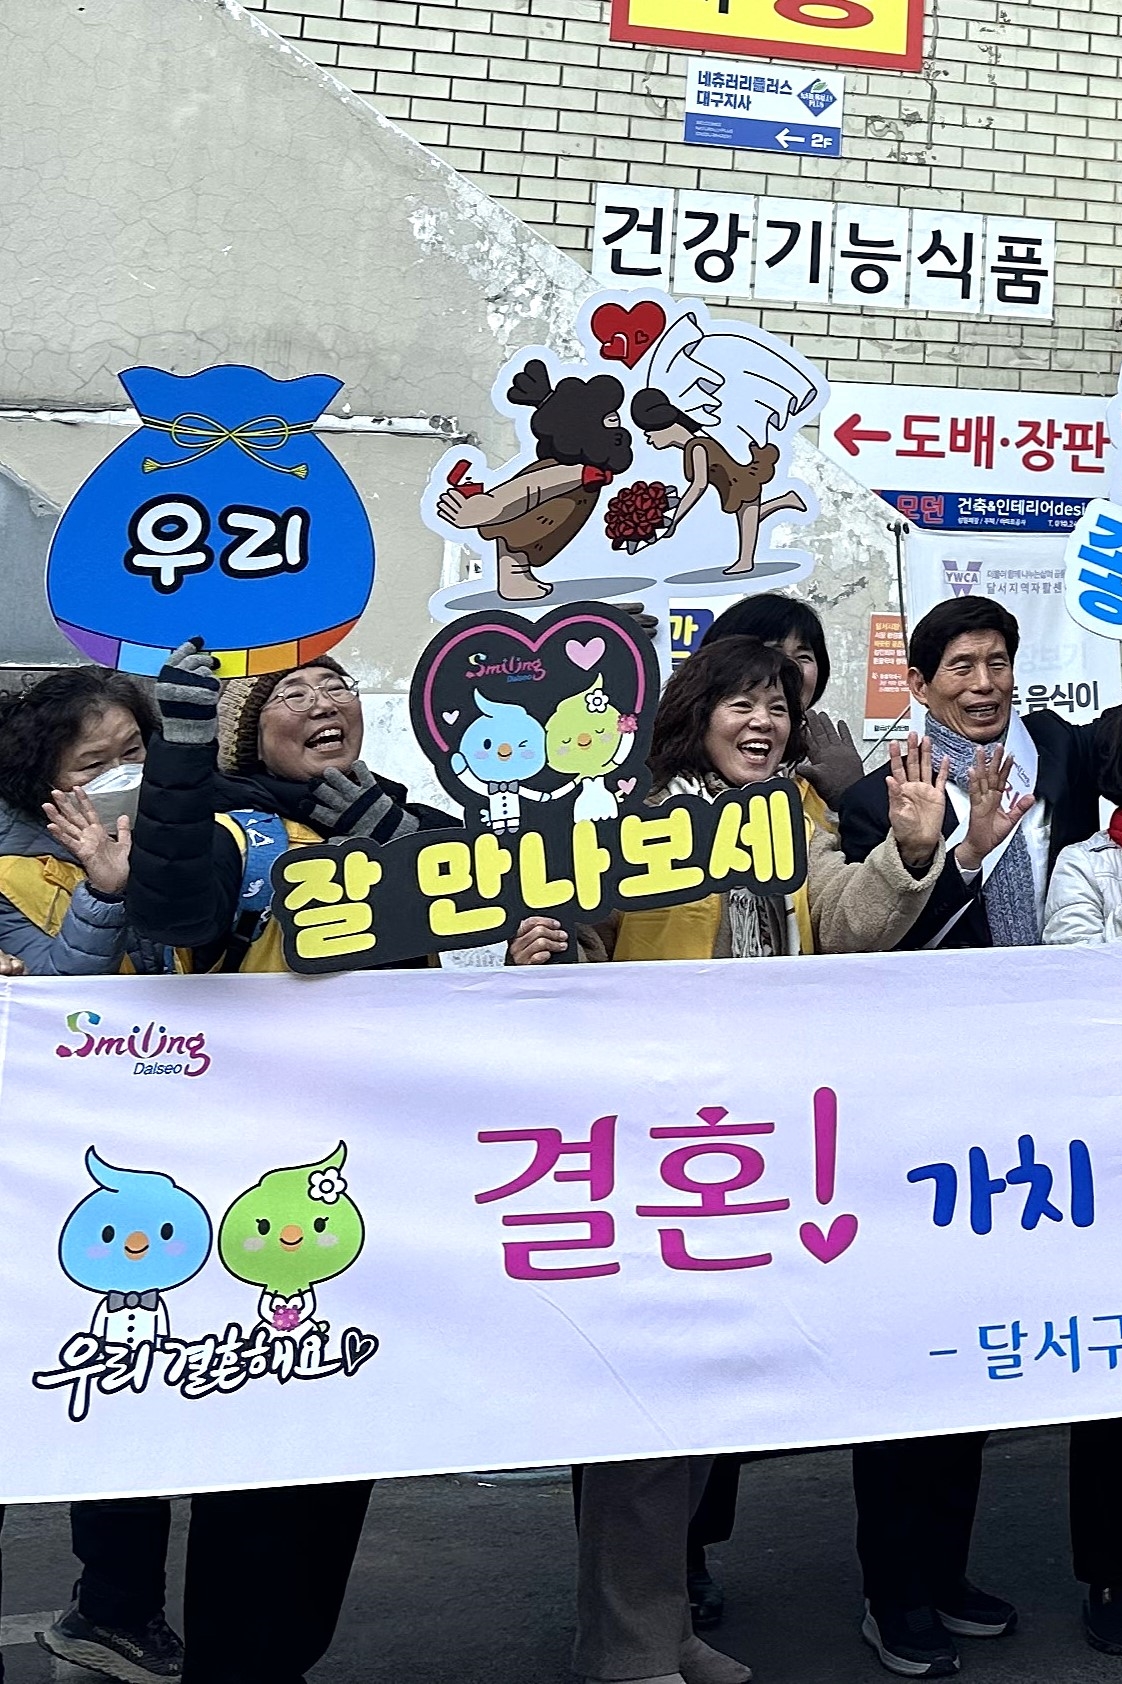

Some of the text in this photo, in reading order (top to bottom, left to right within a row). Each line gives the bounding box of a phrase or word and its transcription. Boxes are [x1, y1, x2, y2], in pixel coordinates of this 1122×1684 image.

[697, 71, 793, 95] 네츄러리플러스
[696, 90, 752, 111] 대구지사
[811, 133, 833, 149] 2F
[602, 204, 1049, 306] 건강기능식품
[896, 414, 1111, 474] 도배·장판
[897, 495, 944, 524] 모던
[129, 500, 305, 588] 우리
[945, 571, 979, 584] YWCA
[465, 653, 547, 681] Smiling
[1026, 681, 1099, 713] 음식이
[282, 789, 795, 958] 잘 만나보세
[55, 1011, 211, 1077] Smiling
[133, 1060, 183, 1075] Dalseo
[474, 1086, 859, 1281] 결혼!
[906, 1134, 1096, 1236] 가치
[32, 1322, 343, 1422] 우리 결혼해요
